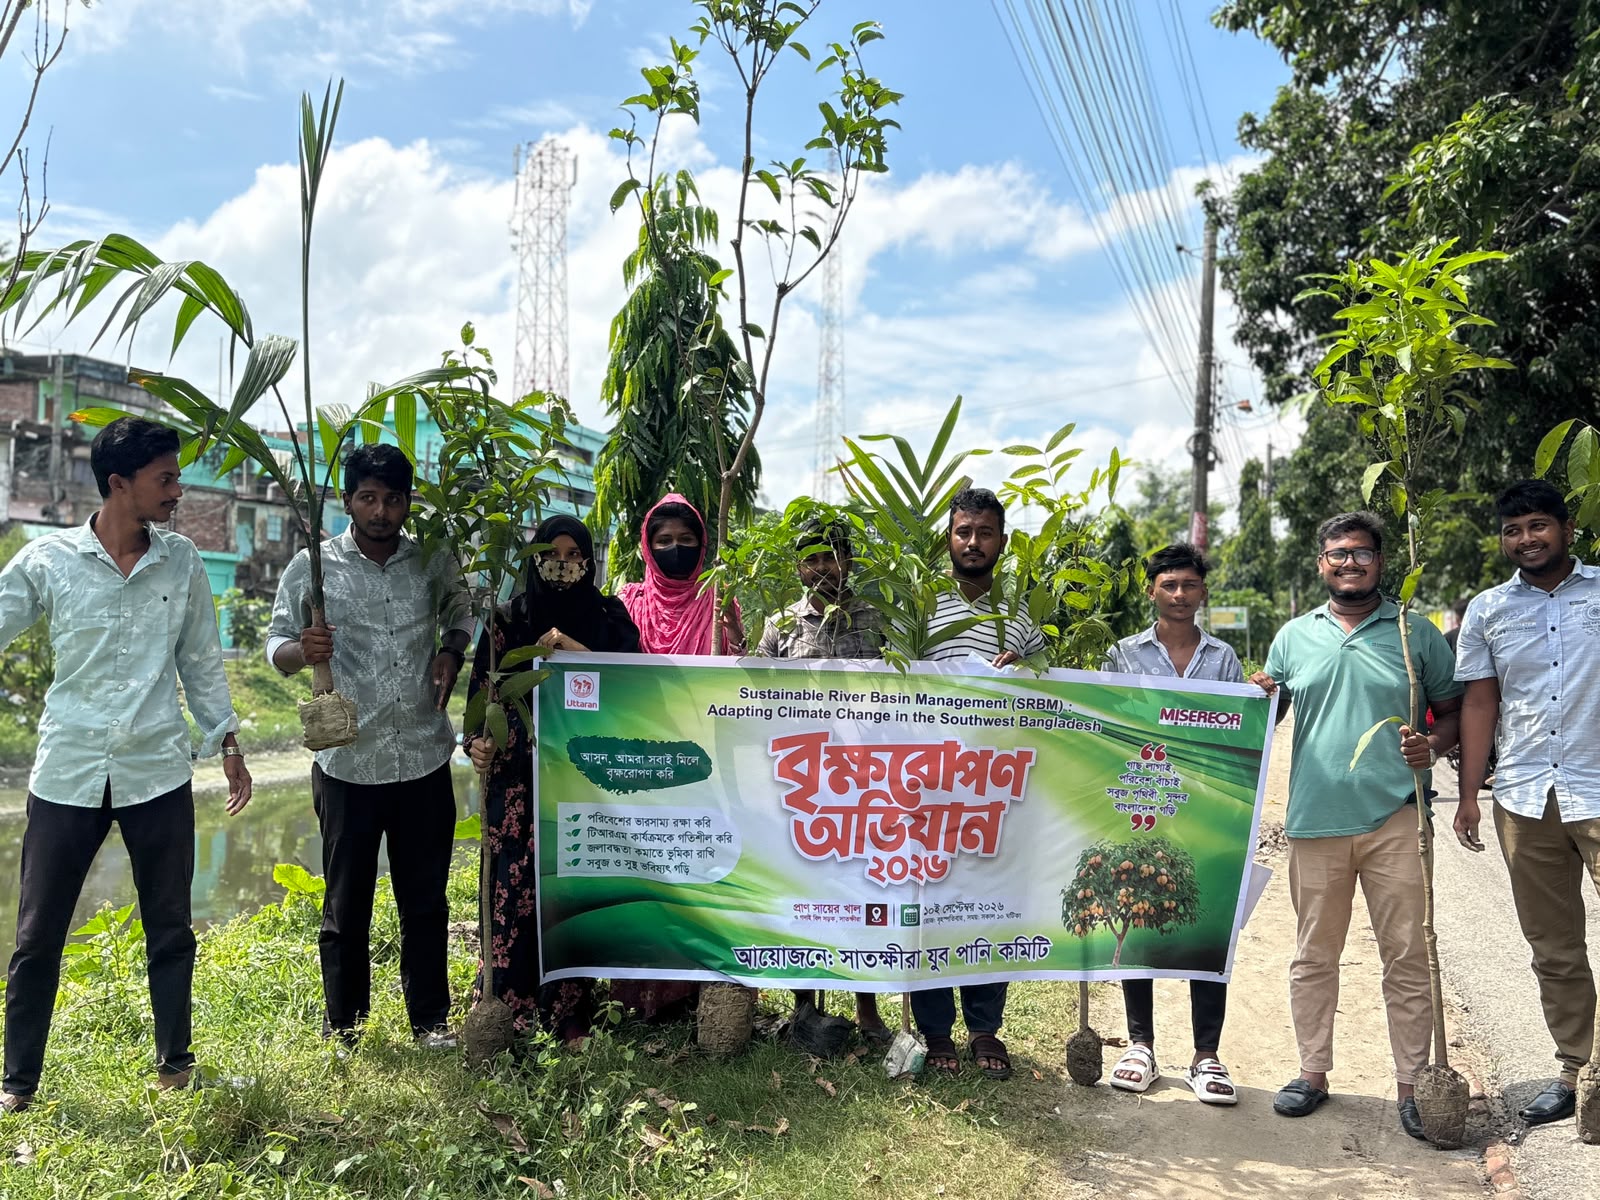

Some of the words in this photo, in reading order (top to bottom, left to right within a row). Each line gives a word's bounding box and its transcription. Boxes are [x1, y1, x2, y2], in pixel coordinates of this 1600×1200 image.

[566, 699, 598, 709] Uttaran
[739, 687, 824, 703] Sustainable
[828, 689, 866, 704] River
[870, 691, 911, 705] Basin
[915, 693, 1008, 711] Management
[1011, 697, 1064, 714] (SRBM)
[707, 703, 773, 720] Adapting
[777, 705, 832, 719] Climate
[836, 707, 891, 724] Change
[895, 709, 908, 721] in
[912, 710, 935, 723] the
[940, 712, 1015, 727] Southwest
[1019, 715, 1102, 733] Bangladesh
[1159, 707, 1241, 726] MISEREOR
[580, 752, 611, 765] আসুন,
[615, 754, 645, 765] আমরা
[648, 753, 673, 765] সবাই
[676, 753, 700, 766] মিলে
[1127, 762, 1142, 771] গাছ
[606, 768, 652, 781] বৃক্ষরোপণ
[656, 768, 674, 780] করি
[771, 732, 1033, 815] বৃক্ষরোপণ
[1119, 773, 1152, 786] পরিবেশ
[1106, 788, 1129, 800] সবুজ
[1165, 792, 1188, 803] সুন্দর
[1115, 803, 1157, 814] বাংলাদেশ
[1159, 805, 1177, 816] গড়ি
[588, 813, 631, 826] পরিবেশের
[635, 816, 670, 828] ভারসাম্য
[673, 817, 692, 828] রক্ষা
[694, 816, 711, 828] করি
[793, 789, 1006, 858] অভিযান
[587, 827, 627, 841] টিআরএম
[630, 830, 675, 844] কার্যক্রমকে
[678, 831, 712, 844] গতিশীল
[715, 831, 732, 844] করি
[587, 844, 632, 856] জলাবদ্ধতা
[634, 848, 664, 860] কমাতে
[696, 848, 715, 860] রাখি
[587, 859, 610, 871] সবুজ
[613, 860, 621, 868] ও
[641, 862, 671, 874] ভবিষ্যৎ
[674, 862, 690, 876] গড়ি
[868, 854, 948, 883] ২০২৬
[793, 903, 810, 913] প্রাণ
[812, 903, 840, 914] সায়ের
[843, 904, 862, 914] খাল
[943, 901, 975, 914] সেপ্টেম্বর
[978, 902, 1005, 912] ২০২৬
[733, 944, 834, 970] আয়োজনে:
[839, 943, 922, 971] সাতক্ষীরা
[926, 948, 950, 973] যুব
[956, 937, 992, 965] পানি
[998, 935, 1052, 961] কমিটি
